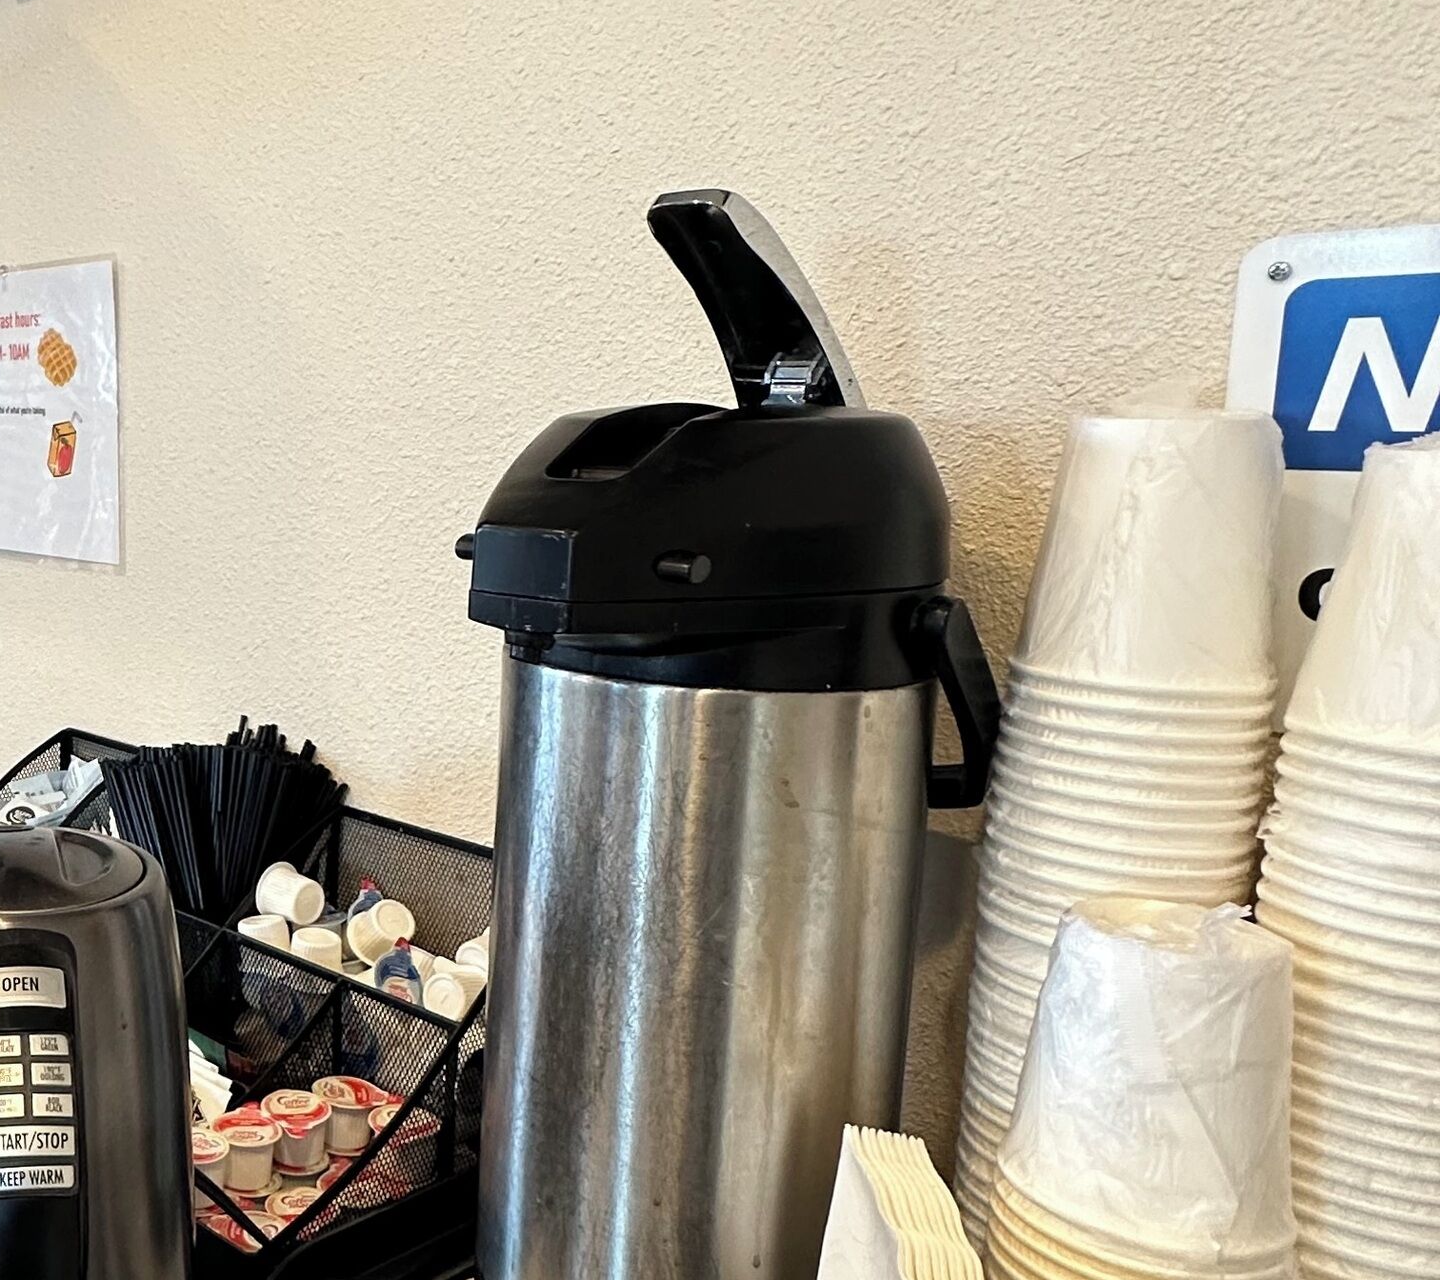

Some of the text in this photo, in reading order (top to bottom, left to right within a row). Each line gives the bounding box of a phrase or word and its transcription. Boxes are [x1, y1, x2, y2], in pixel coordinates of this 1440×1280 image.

[14, 311, 41, 328] hours:
[9, 343, 30, 361] 10AM
[2, 977, 39, 992] OPEN
[0, 1169, 65, 1187] KEEP WARM
